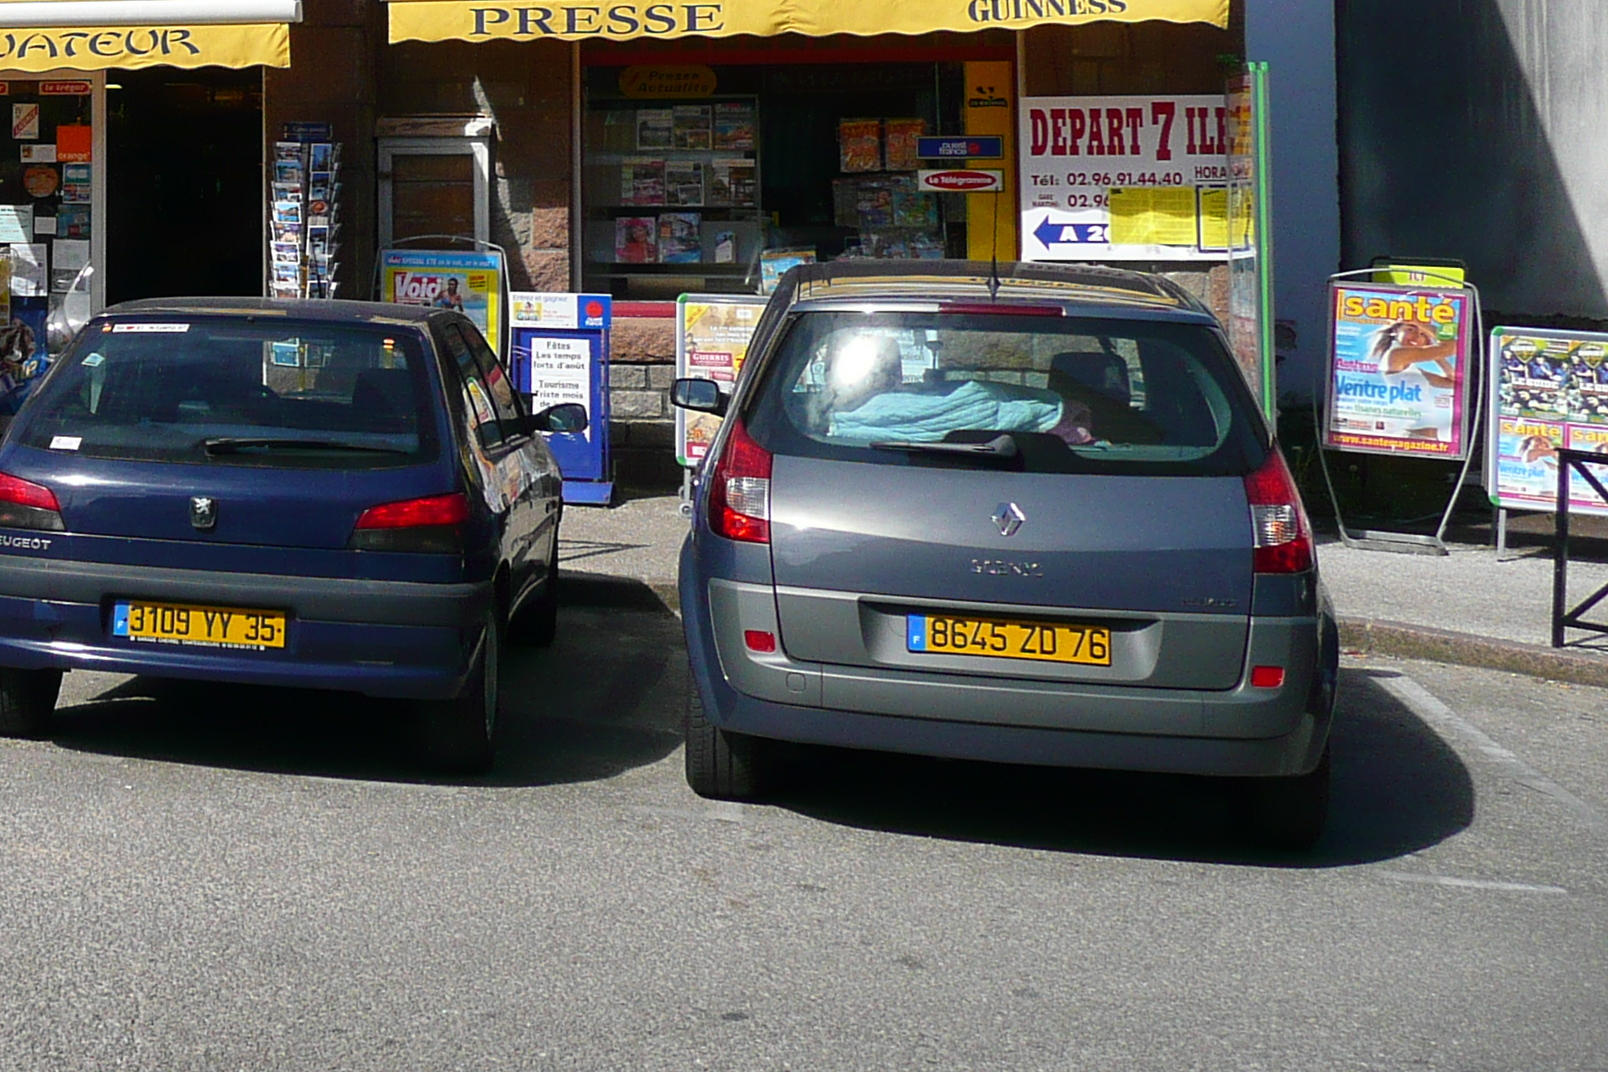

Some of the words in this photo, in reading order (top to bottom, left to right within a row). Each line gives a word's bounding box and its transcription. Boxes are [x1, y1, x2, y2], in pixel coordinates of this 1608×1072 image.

[468, 4, 725, 36] PRESSE
[648, 70, 700, 81] Presse
[1030, 107, 1143, 156] DEPART
[1151, 101, 1176, 161] 7
[58, 152, 87, 162] orange
[939, 147, 967, 156] france
[1195, 166, 1228, 179] HORA
[929, 176, 939, 184] Le
[940, 175, 993, 186] Télégramme
[1067, 173, 1183, 186] 02.96.91.44.40
[1059, 226, 1079, 242] A
[395, 272, 443, 298] Voici
[1345, 295, 1455, 324] santé
[546, 341, 571, 350] Fêtes
[536, 351, 551, 359] Les
[554, 352, 582, 360] temps
[557, 361, 585, 369] d'août
[539, 380, 579, 388] Tourisme
[1335, 375, 1387, 399] Ventre
[1389, 380, 1422, 404] plat
[535, 390, 559, 398] Triste
[562, 391, 583, 399] mois
[129, 605, 190, 635] 3109
[203, 611, 233, 638] YY
[244, 615, 276, 642] 35
[931, 619, 1007, 652] 8645
[1020, 625, 1056, 657] ZD
[1069, 629, 1108, 660] 76
